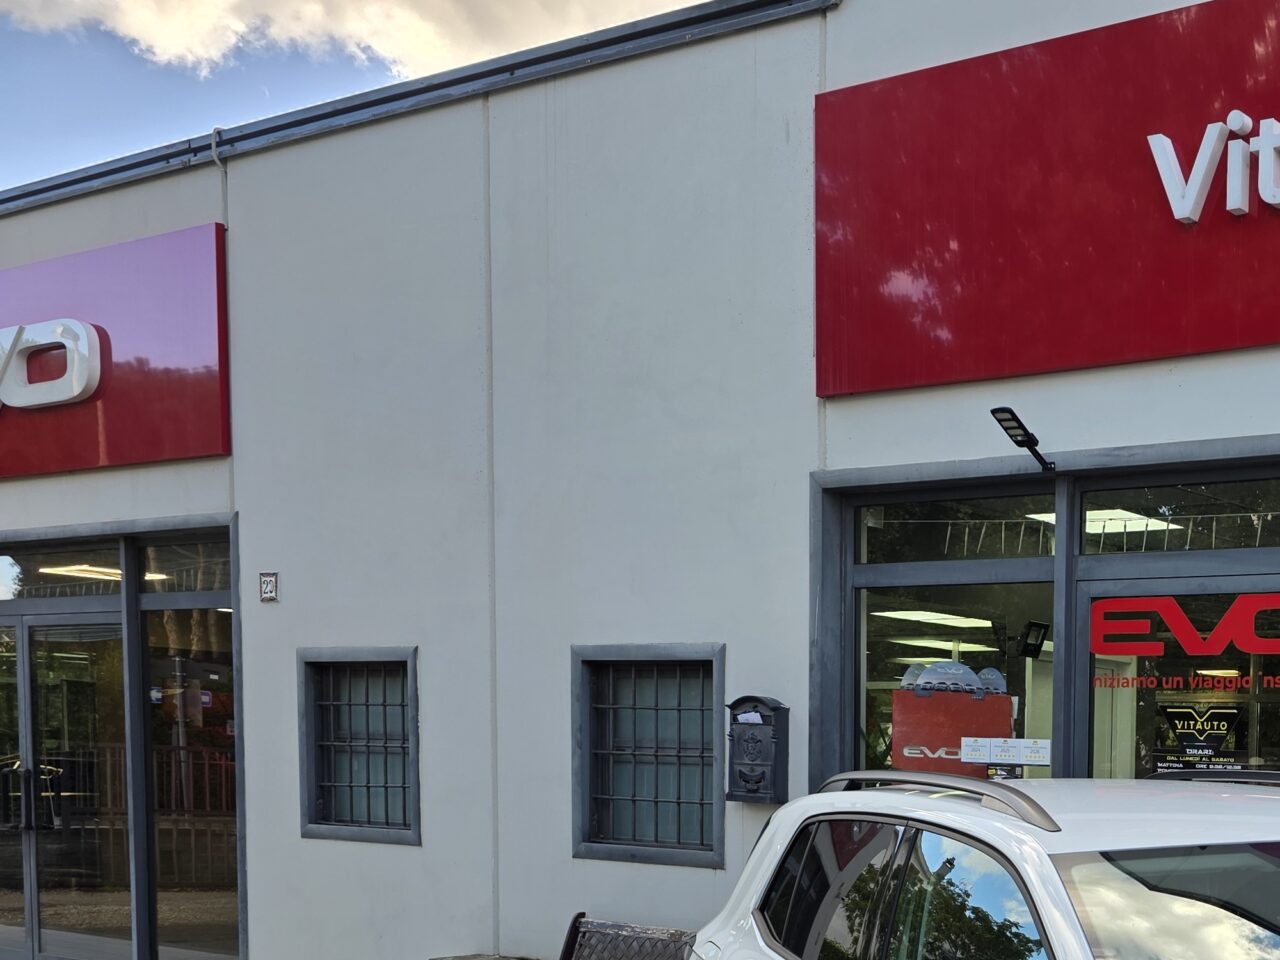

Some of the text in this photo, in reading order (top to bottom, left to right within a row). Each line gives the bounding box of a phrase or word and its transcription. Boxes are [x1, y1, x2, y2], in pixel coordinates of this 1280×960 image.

[0, 318, 101, 408] O
[1162, 676, 1184, 688] un
[1189, 671, 1253, 691] viaggio
[1175, 720, 1228, 730] VITAUTO
[903, 747, 962, 759] EVO
